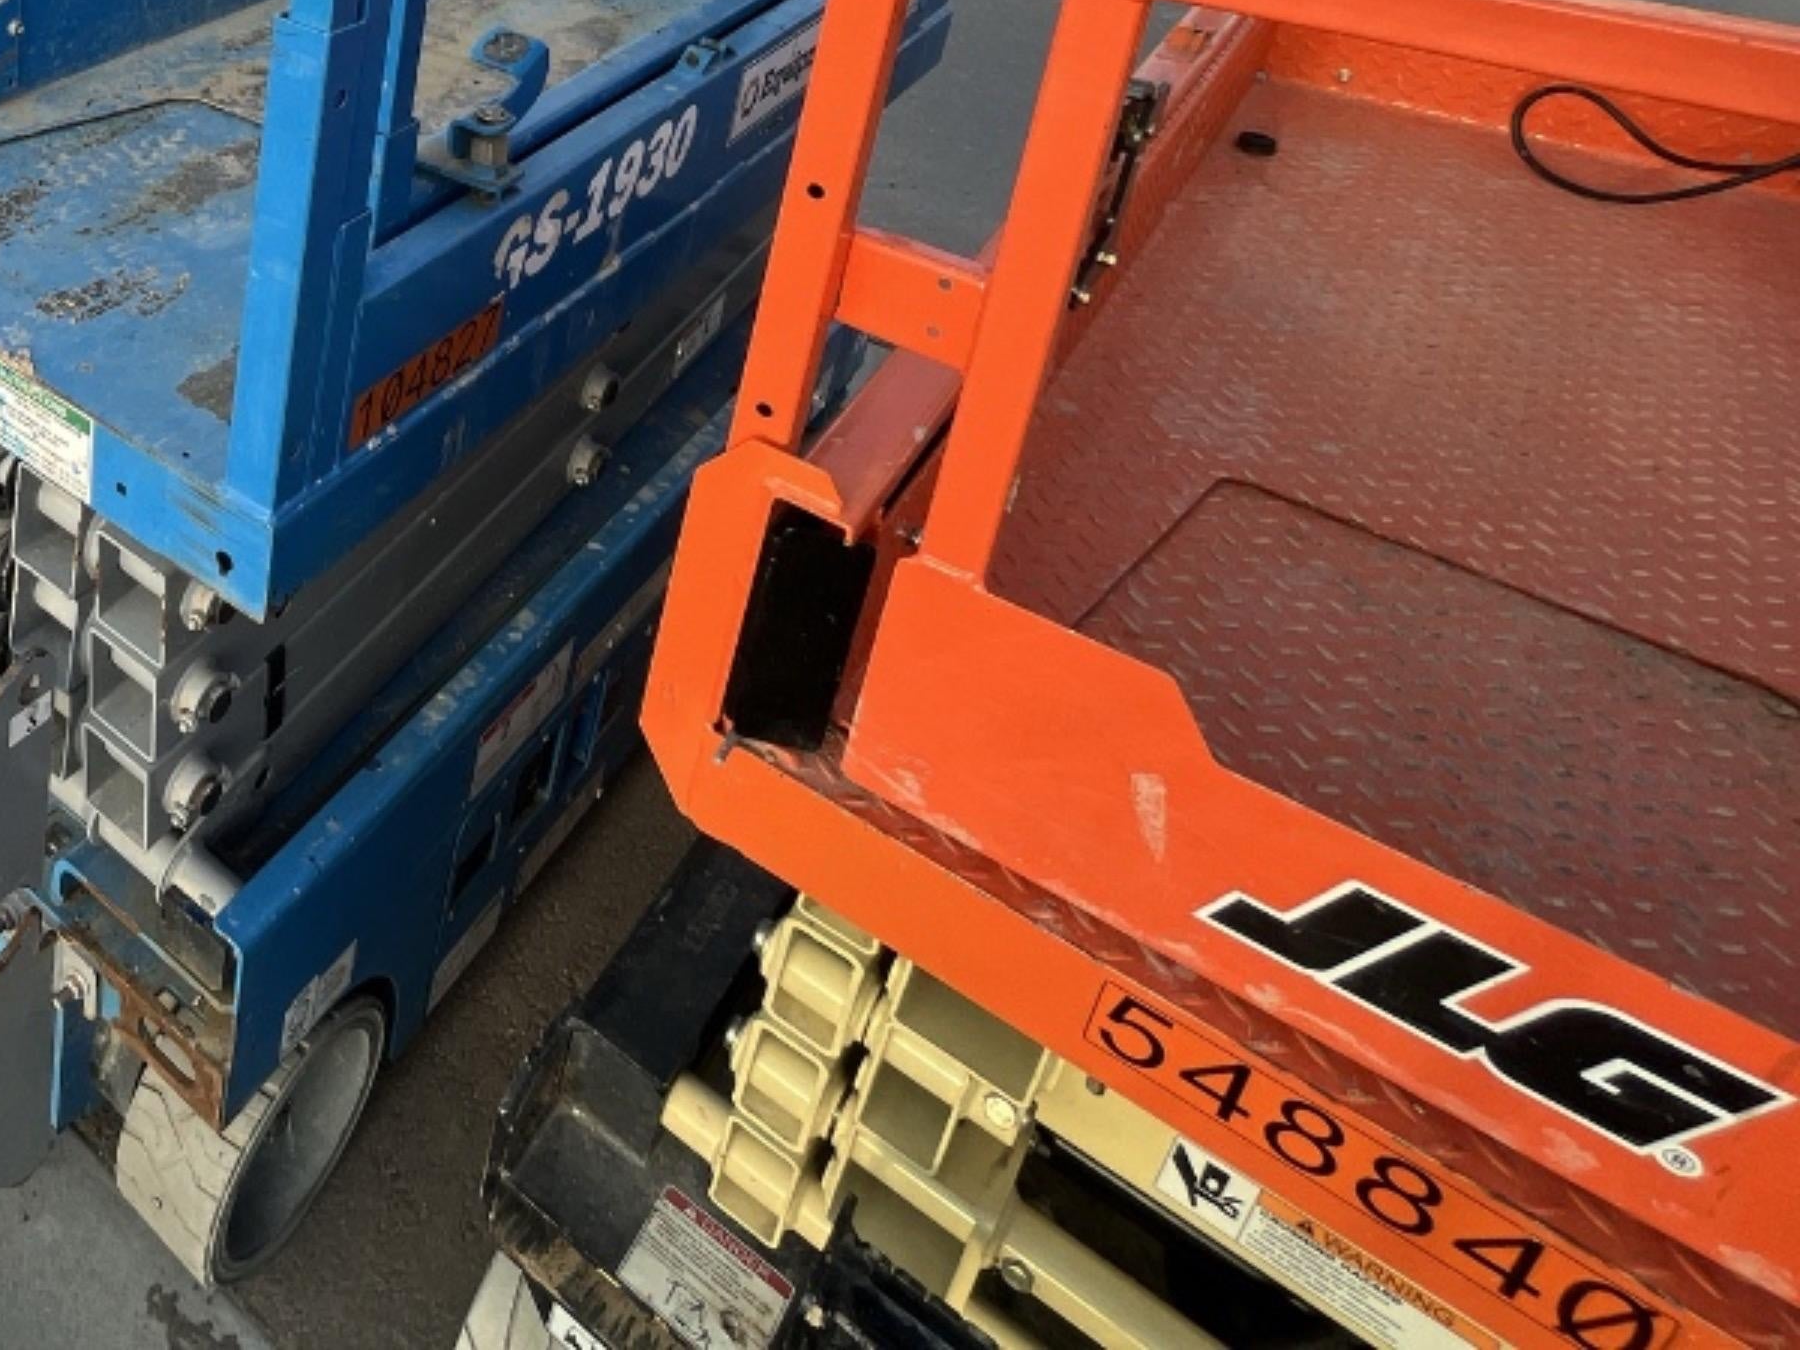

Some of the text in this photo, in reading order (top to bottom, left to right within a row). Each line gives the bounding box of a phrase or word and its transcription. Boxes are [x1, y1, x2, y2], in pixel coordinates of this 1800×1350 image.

[495, 104, 697, 290] GS-1930
[358, 300, 501, 438] 104827
[1193, 878, 1797, 1156] JLG
[1098, 995, 1660, 1350] 5488840
[1321, 1230, 1455, 1328] WARNING
